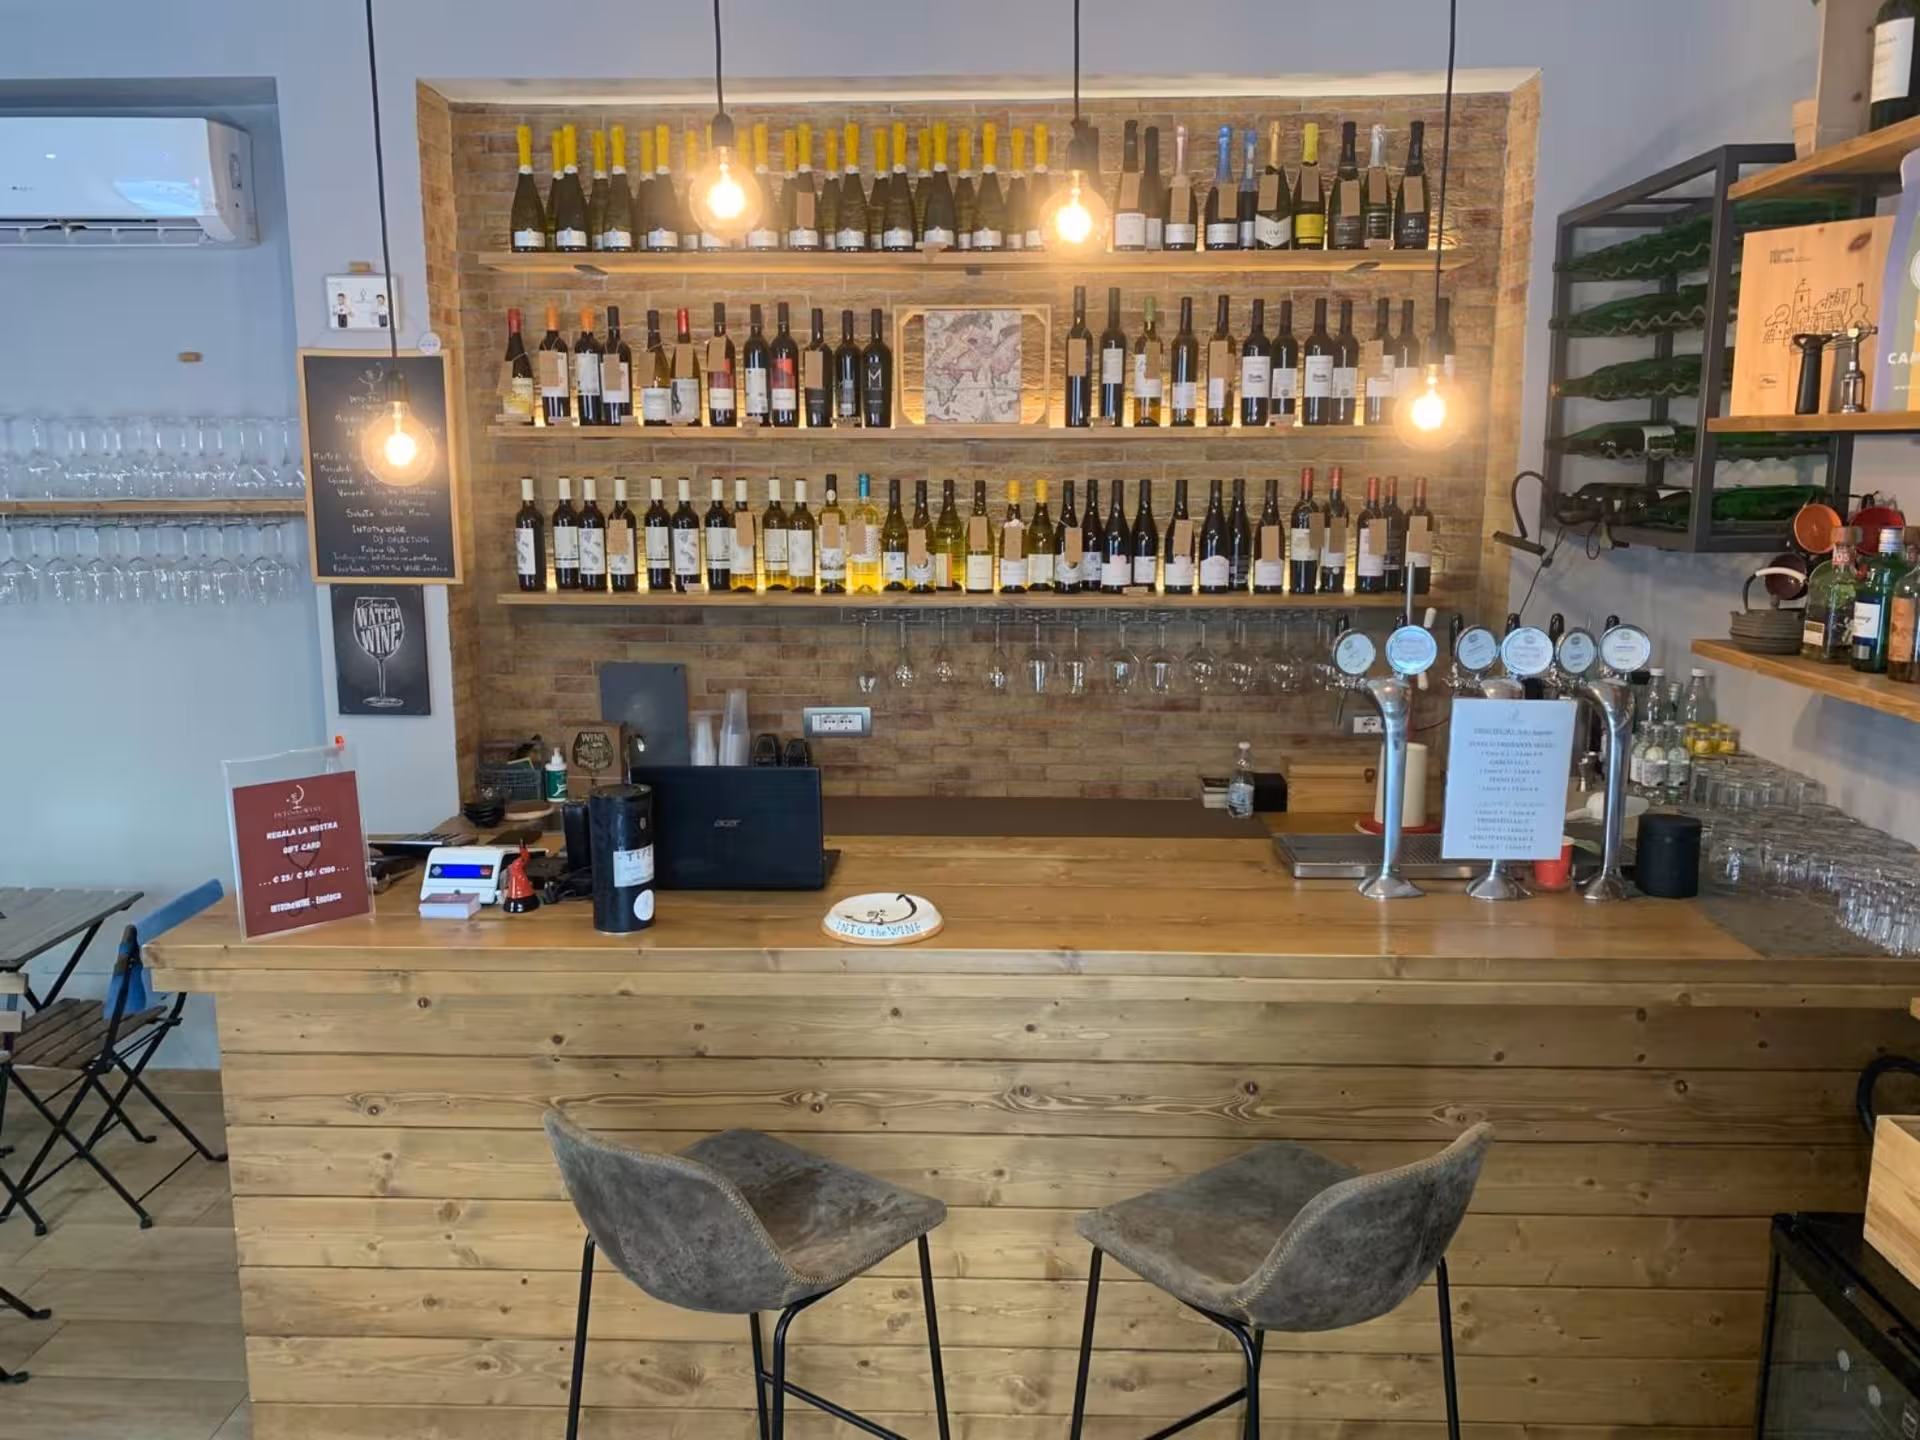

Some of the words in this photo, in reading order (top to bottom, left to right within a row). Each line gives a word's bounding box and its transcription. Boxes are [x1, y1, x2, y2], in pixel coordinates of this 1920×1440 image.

[356, 607, 400, 628] WATER
[360, 621, 402, 654] WINE
[266, 828, 297, 840] REGALA
[298, 826, 308, 835] LA
[310, 821, 338, 833] NOSTRA
[713, 819, 743, 828] acer
[282, 843, 299, 855] GIFT
[301, 841, 322, 851] CARD
[835, 921, 866, 936] INTO
[870, 927, 886, 937] the
[886, 921, 922, 937] WINE
